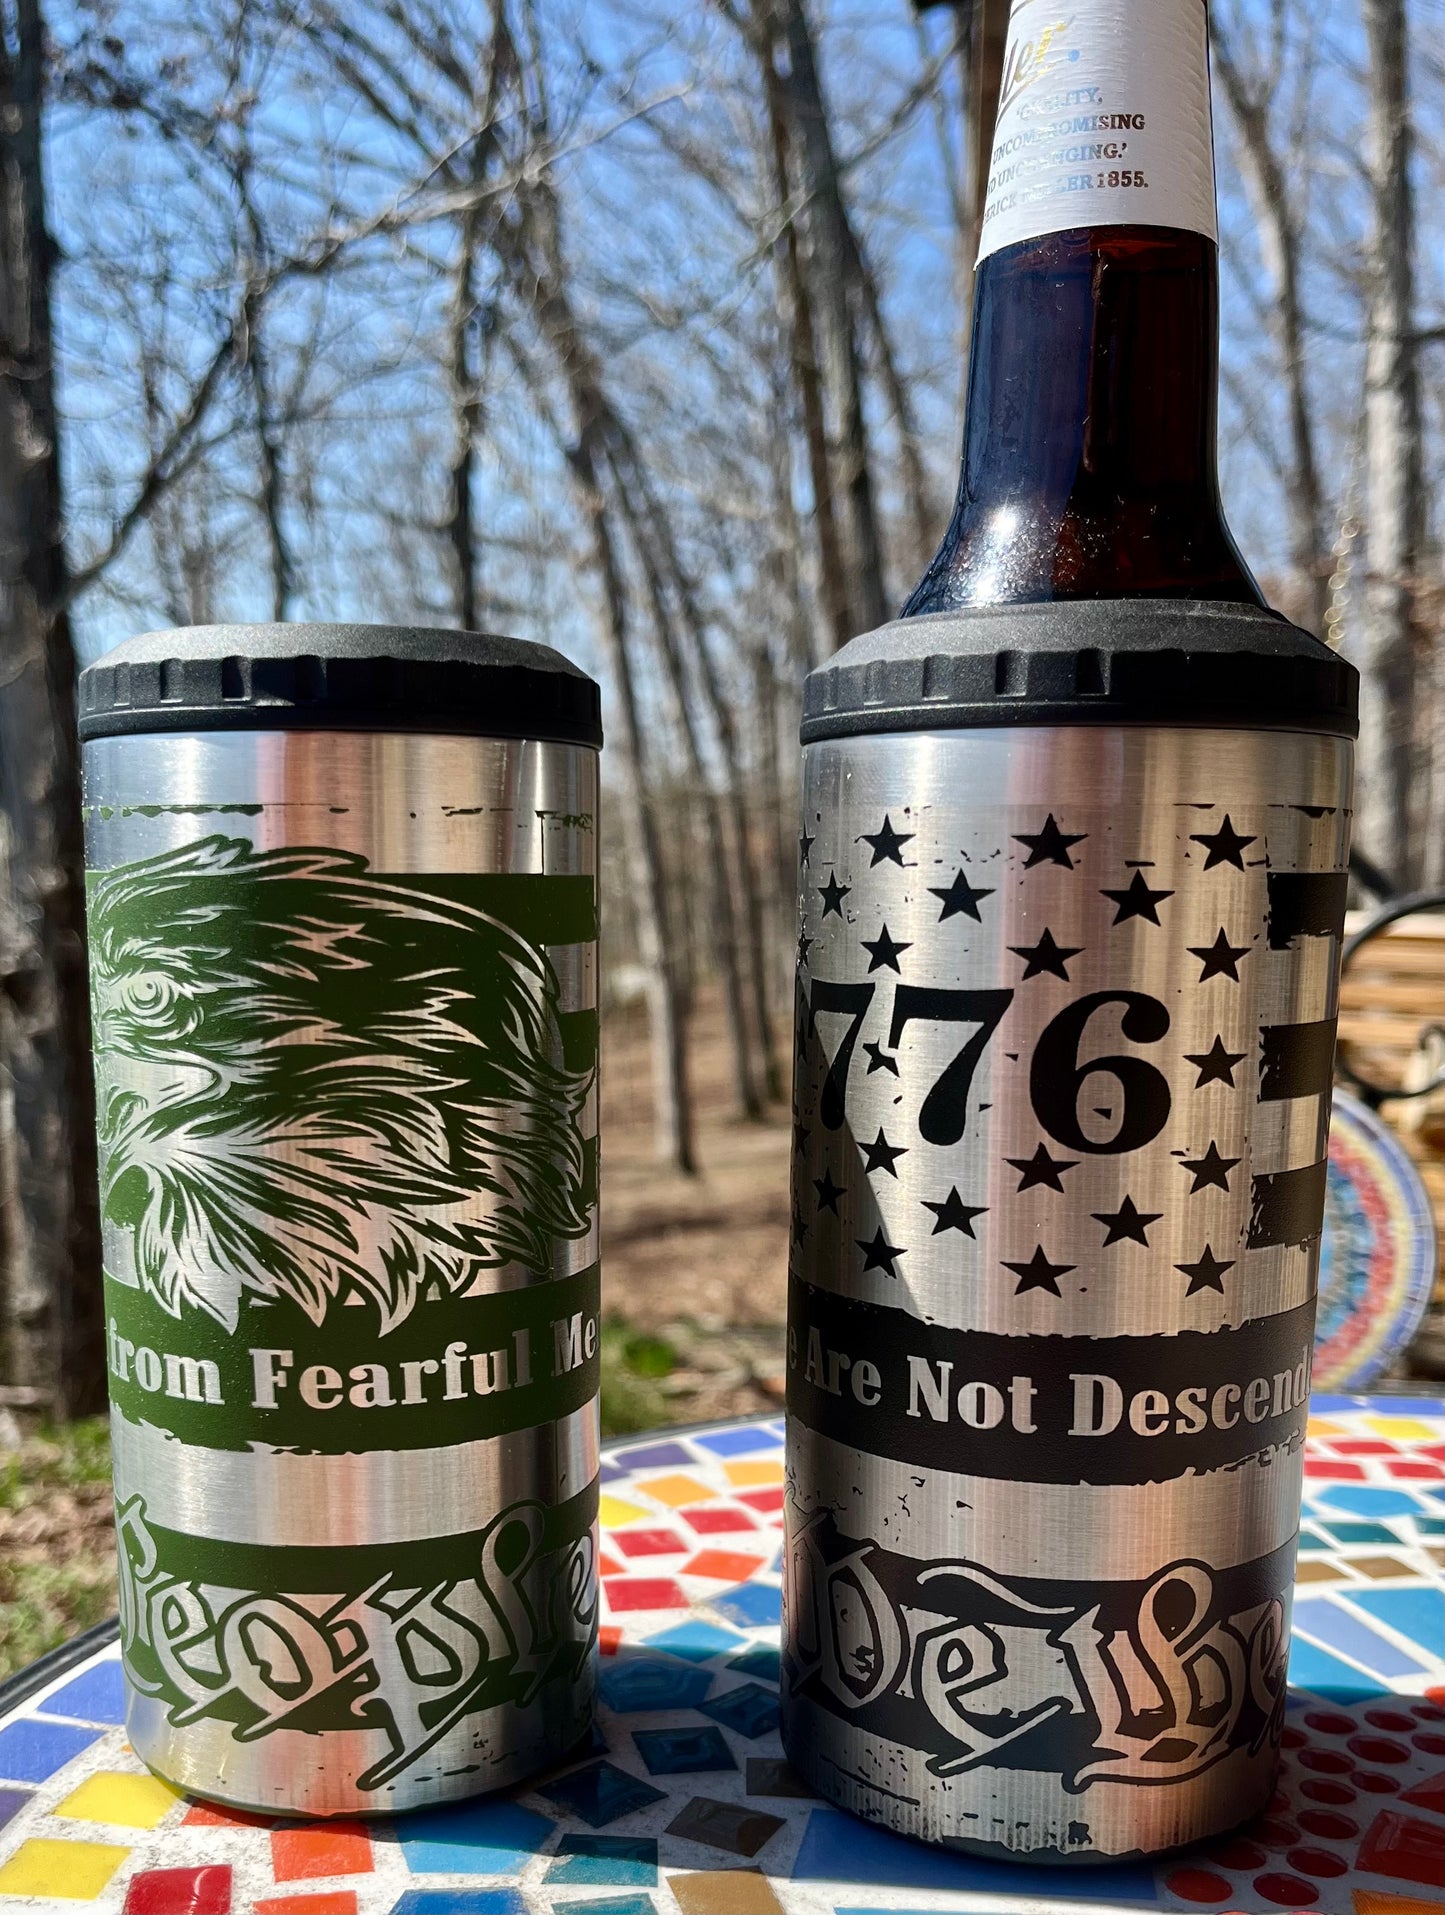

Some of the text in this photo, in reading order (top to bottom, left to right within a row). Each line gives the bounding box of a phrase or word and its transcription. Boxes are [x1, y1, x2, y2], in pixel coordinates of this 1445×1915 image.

[1097, 170, 1149, 189] 1855.
[108, 1310, 600, 1411] from Fearful Me
[804, 1325, 882, 1407] Are
[905, 1354, 1039, 1435] Not
